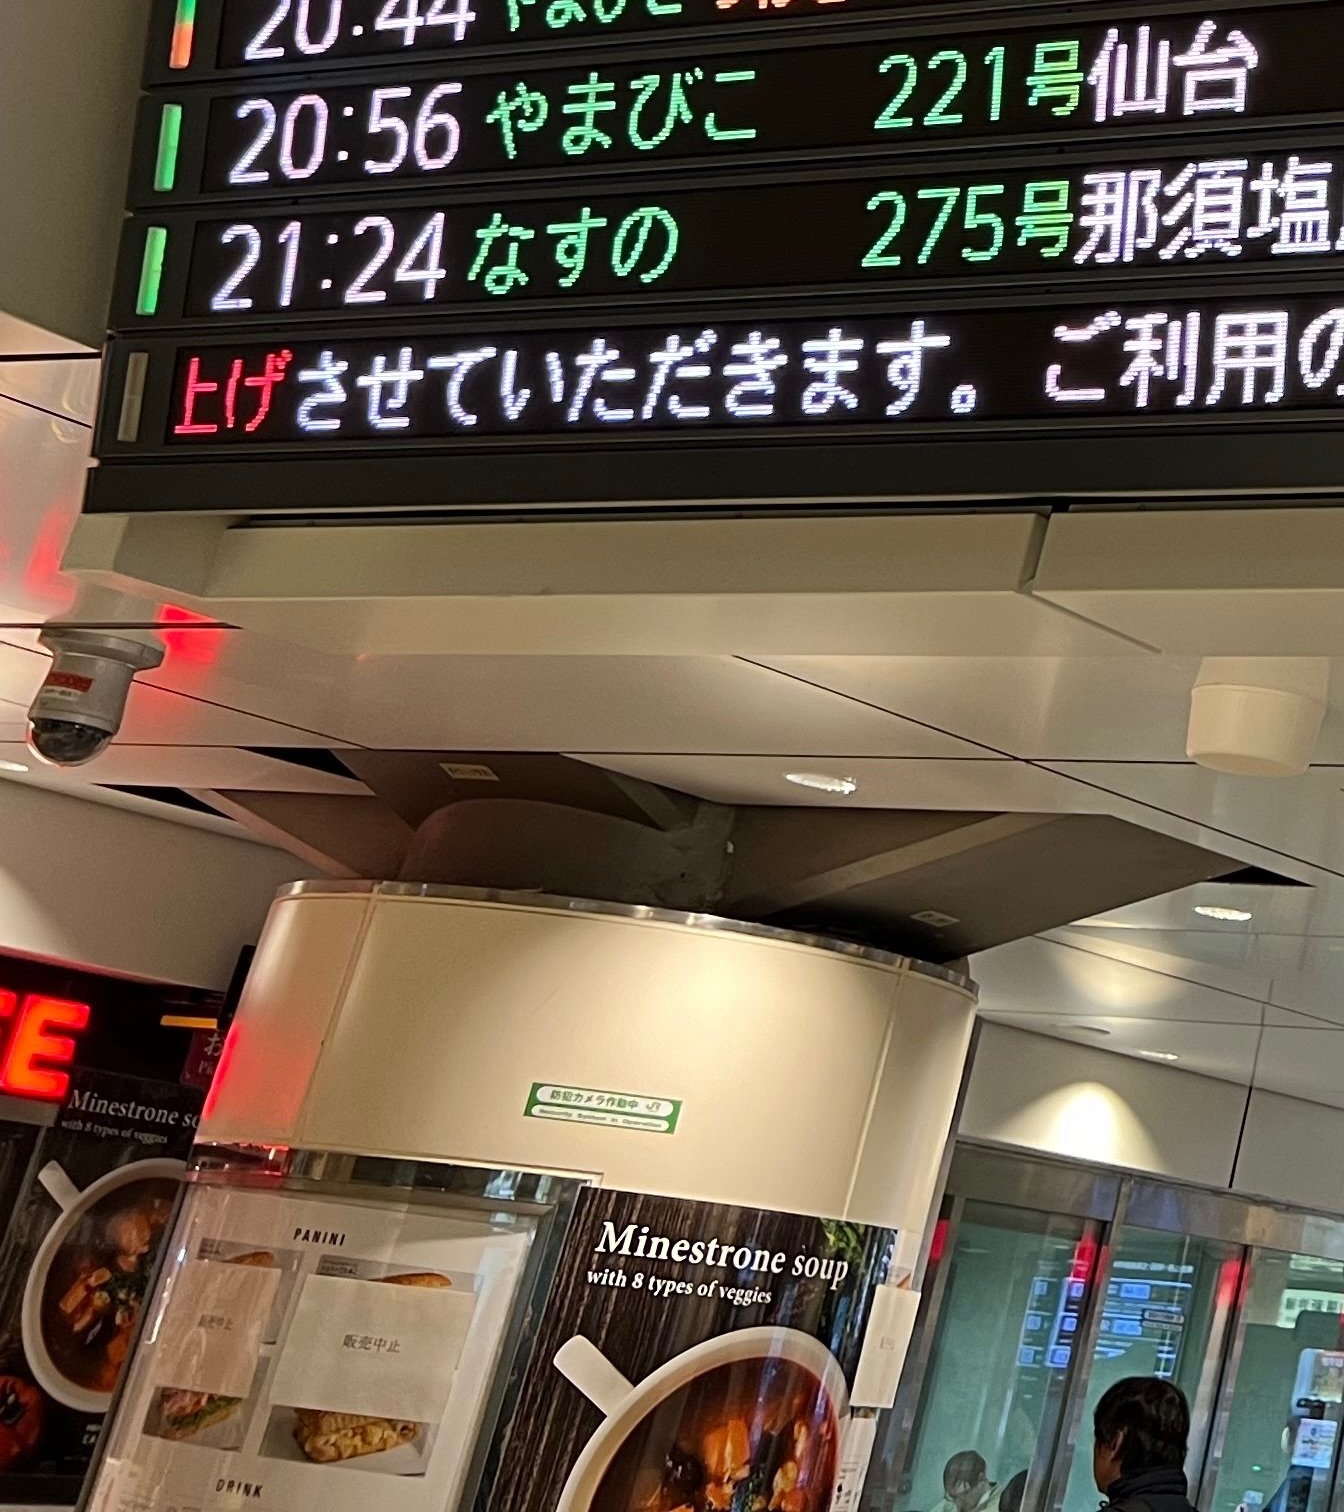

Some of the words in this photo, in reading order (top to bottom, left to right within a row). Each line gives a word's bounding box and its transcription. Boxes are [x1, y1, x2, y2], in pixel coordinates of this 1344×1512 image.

[228, 82, 463, 185] 20:56
[485, 68, 757, 159] やまびこ
[873, 38, 1083, 130] 221号
[1087, 19, 1260, 123] 仙台
[210, 211, 448, 312] 21:24
[467, 205, 679, 295] なすの
[861, 179, 1076, 268] 275号
[67, 1088, 180, 1126] Minestrone
[292, 1227, 347, 1248] PANINI
[594, 1220, 787, 1274] Minestrone
[791, 1252, 849, 1291] soup
[586, 1268, 628, 1289] with
[631, 1271, 645, 1290] 8
[647, 1276, 694, 1297] types
[696, 1278, 719, 1298] of
[719, 1285, 773, 1307] veggies
[342, 1333, 401, 1354] 販売中止
[215, 1477, 264, 1498] DRINK
